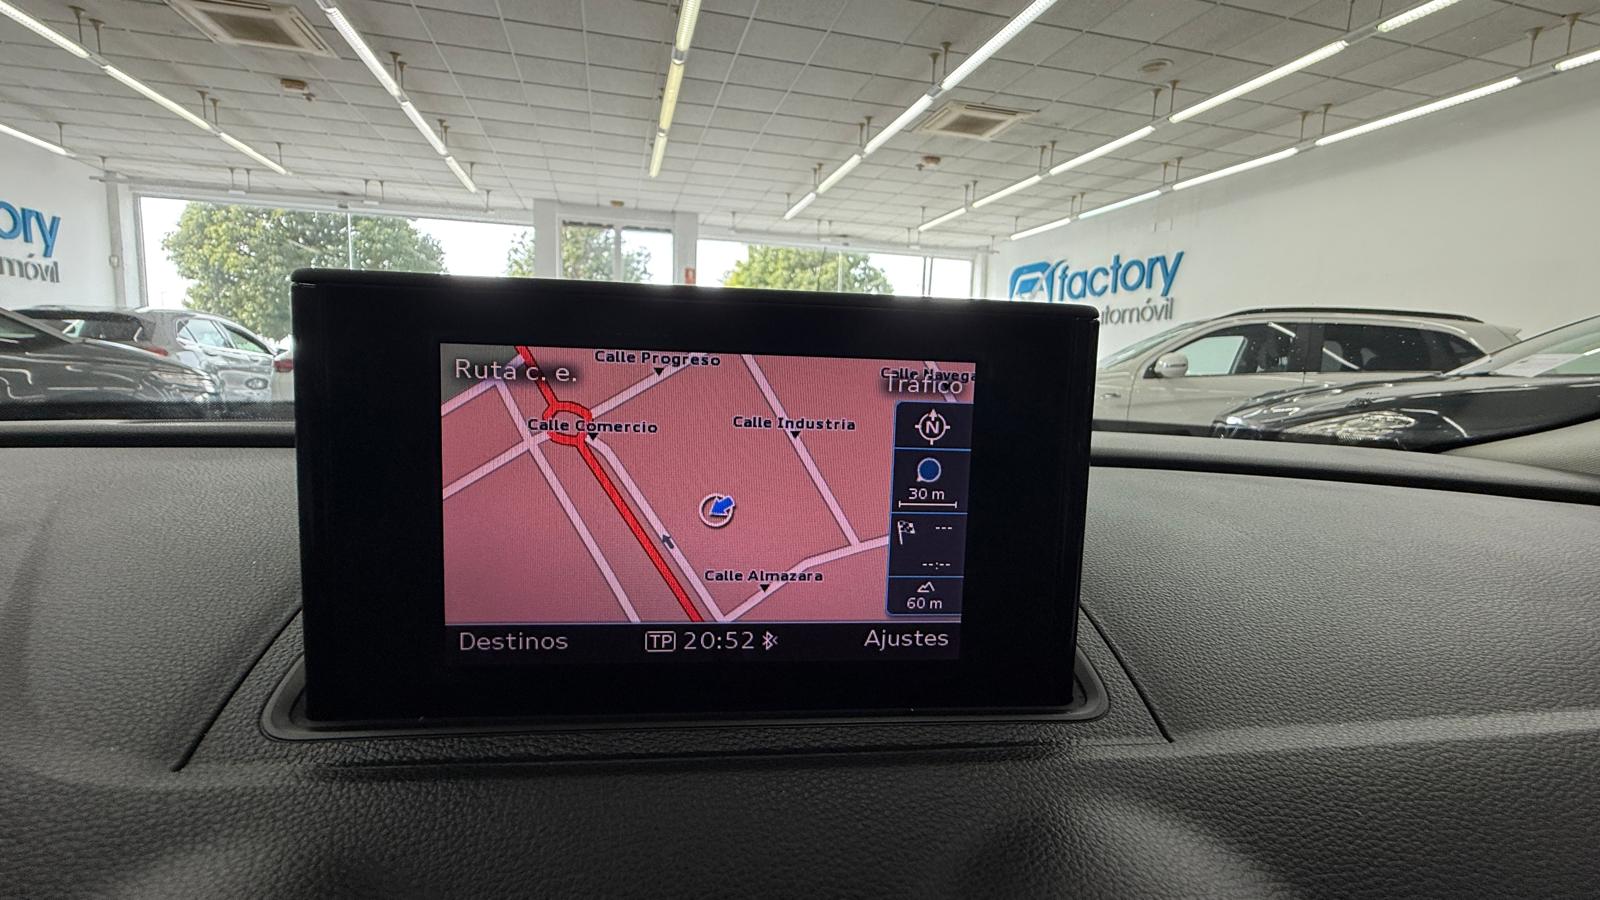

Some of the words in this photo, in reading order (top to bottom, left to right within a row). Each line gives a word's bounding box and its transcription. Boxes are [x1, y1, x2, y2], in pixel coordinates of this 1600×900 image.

[594, 350, 636, 364] Calle
[641, 351, 721, 366] Progreso
[454, 358, 517, 380] Ruta
[527, 418, 569, 432] Calle
[575, 419, 658, 434] Comercio
[733, 415, 772, 429] Calle
[777, 416, 856, 431] Industria
[908, 487, 928, 501] 30
[932, 490, 945, 501] m
[704, 570, 743, 582] Calle
[747, 569, 823, 582] Almazara
[906, 597, 926, 610] 60
[929, 599, 943, 610] m
[459, 631, 569, 651] Destinos
[649, 633, 674, 648] TP
[683, 631, 756, 651] 20:52
[864, 629, 950, 651] Ajustes
